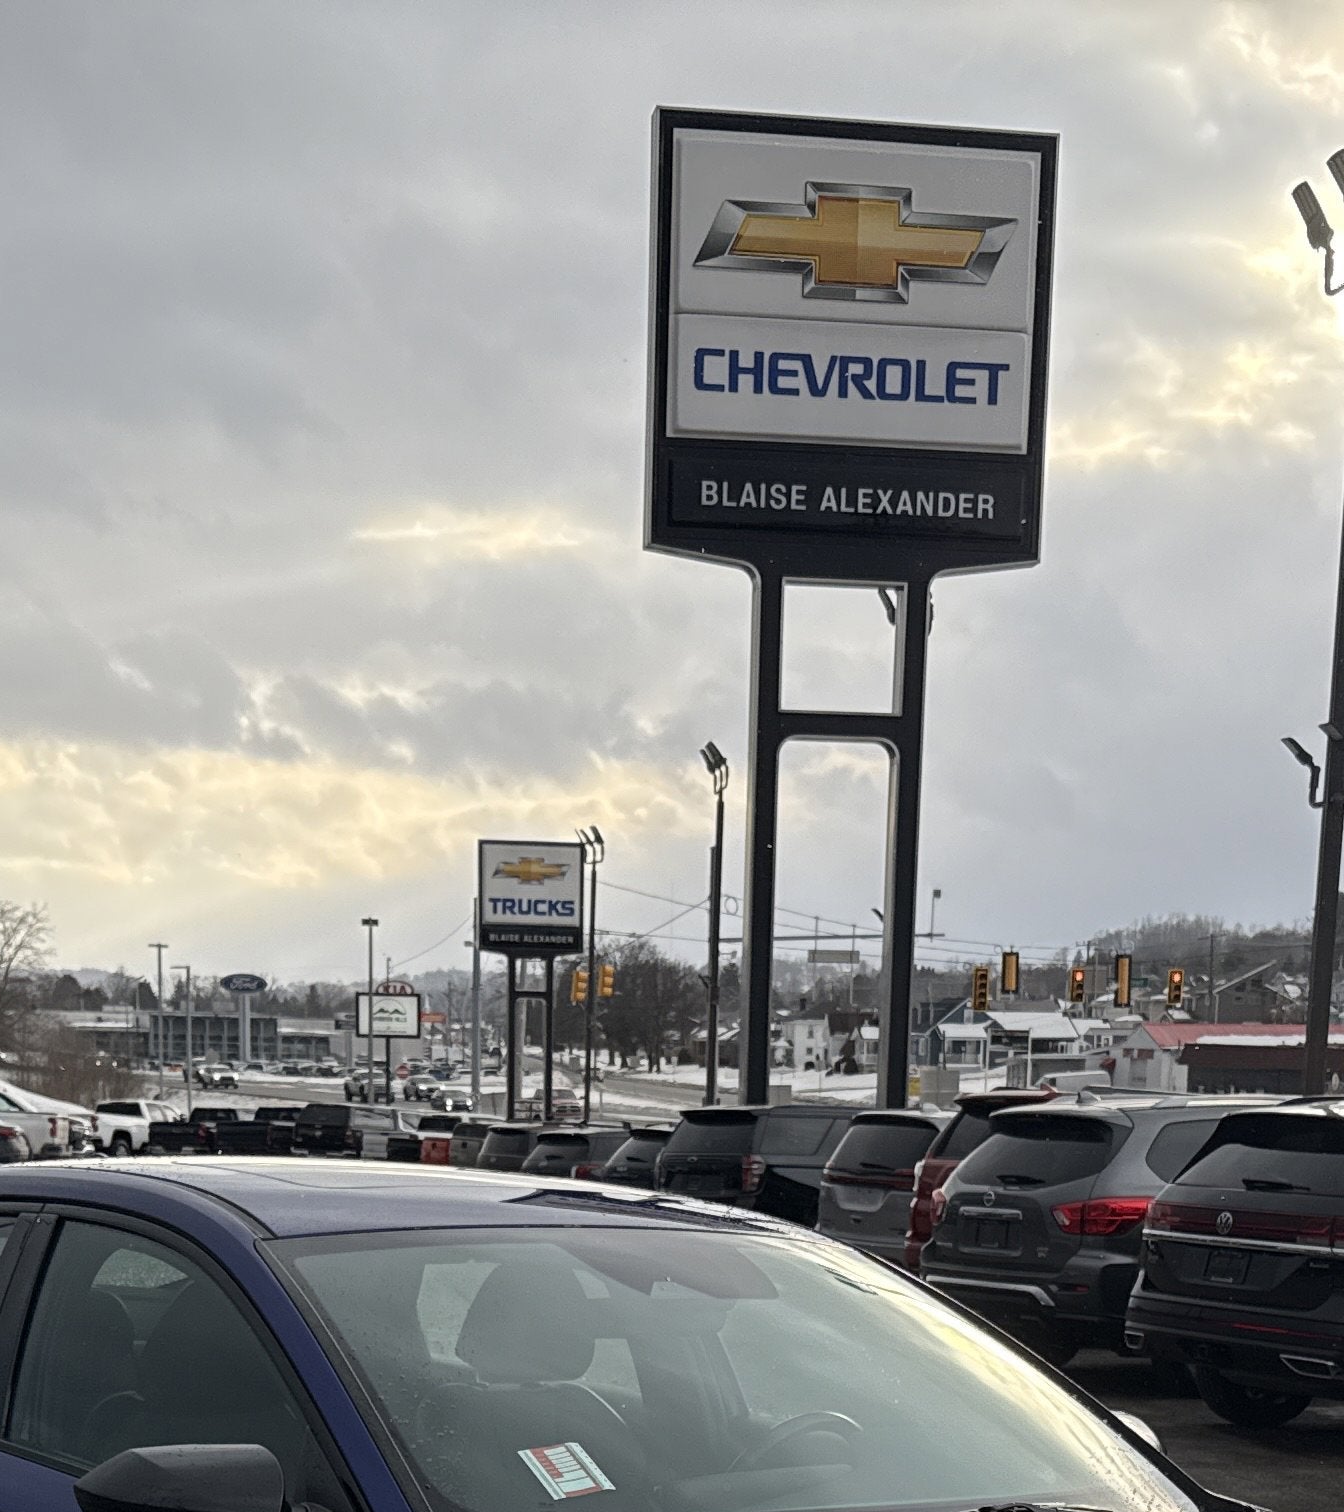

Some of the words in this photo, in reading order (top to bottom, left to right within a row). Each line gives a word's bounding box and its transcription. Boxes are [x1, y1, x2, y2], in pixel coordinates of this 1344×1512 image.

[694, 347, 1010, 406] CHEVROLET
[700, 480, 807, 511] BLAISE
[819, 486, 995, 520] ALEXANDER
[488, 897, 575, 917] TRUCKS
[489, 933, 521, 943] BLAISE
[523, 934, 574, 944] ALEXANDER
